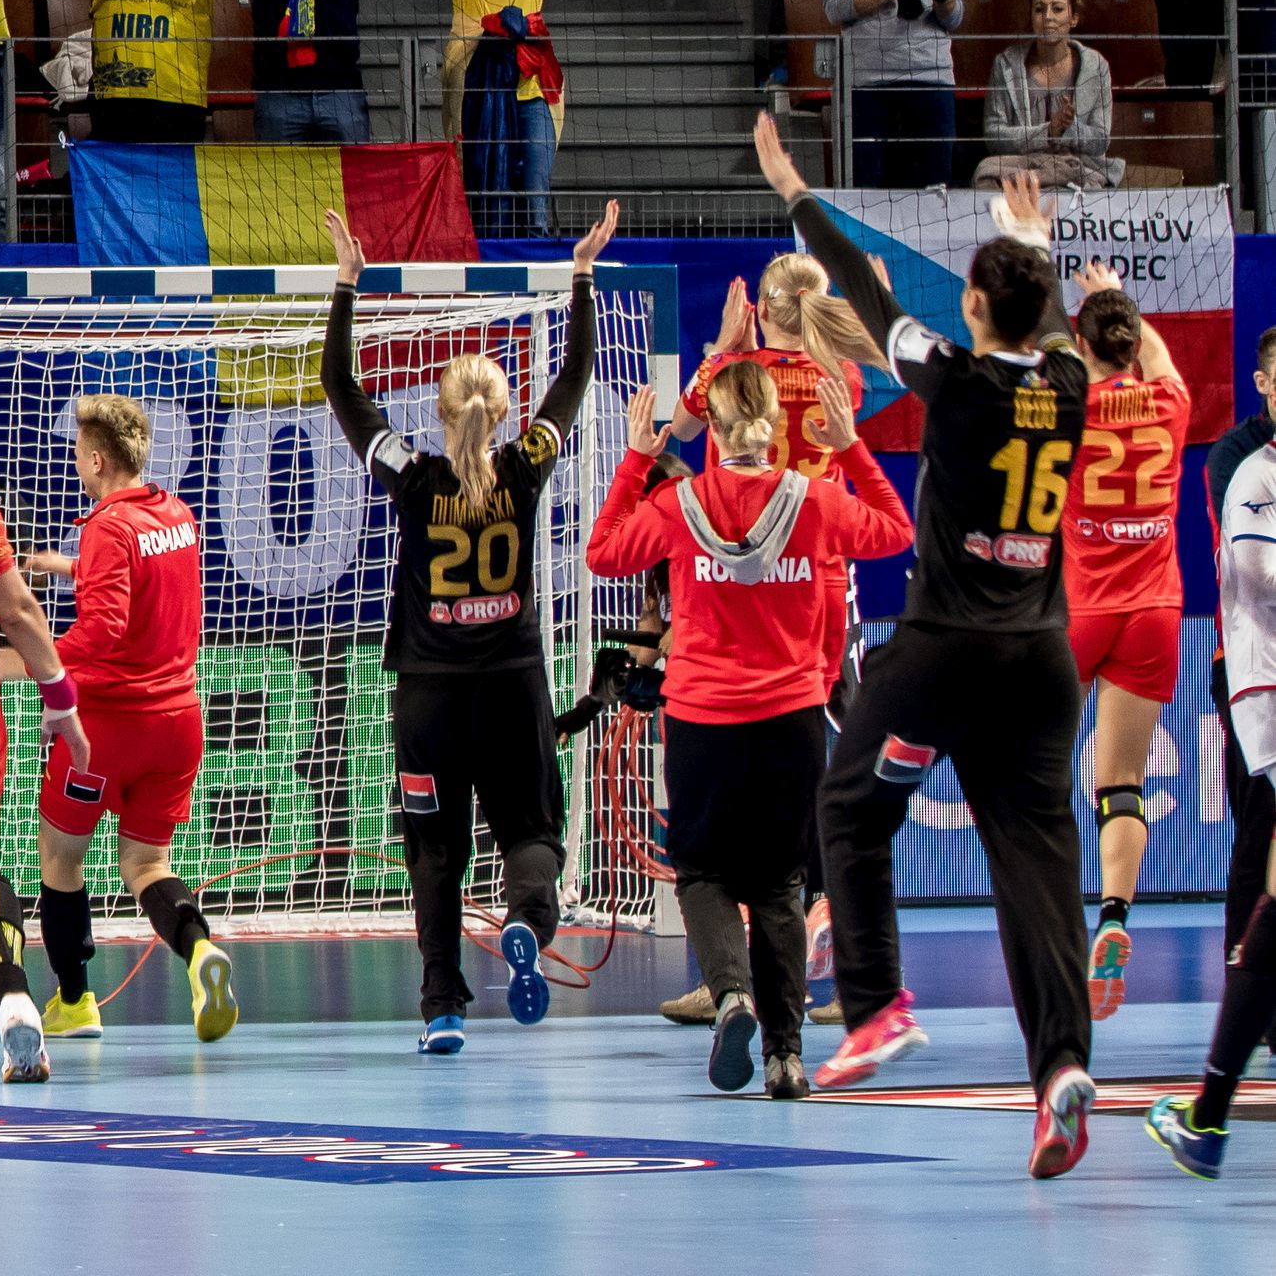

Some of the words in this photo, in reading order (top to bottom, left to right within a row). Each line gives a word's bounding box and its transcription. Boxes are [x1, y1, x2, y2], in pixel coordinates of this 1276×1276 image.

[110, 12, 172, 39] NIRO
[1050, 212, 1194, 245] DŘICHŮV
[989, 437, 1073, 535] 16
[1083, 427, 1175, 509] 22
[427, 521, 521, 597] 20
[460, 600, 515, 623] PROFI
[98, 1135, 718, 1175] 1000
